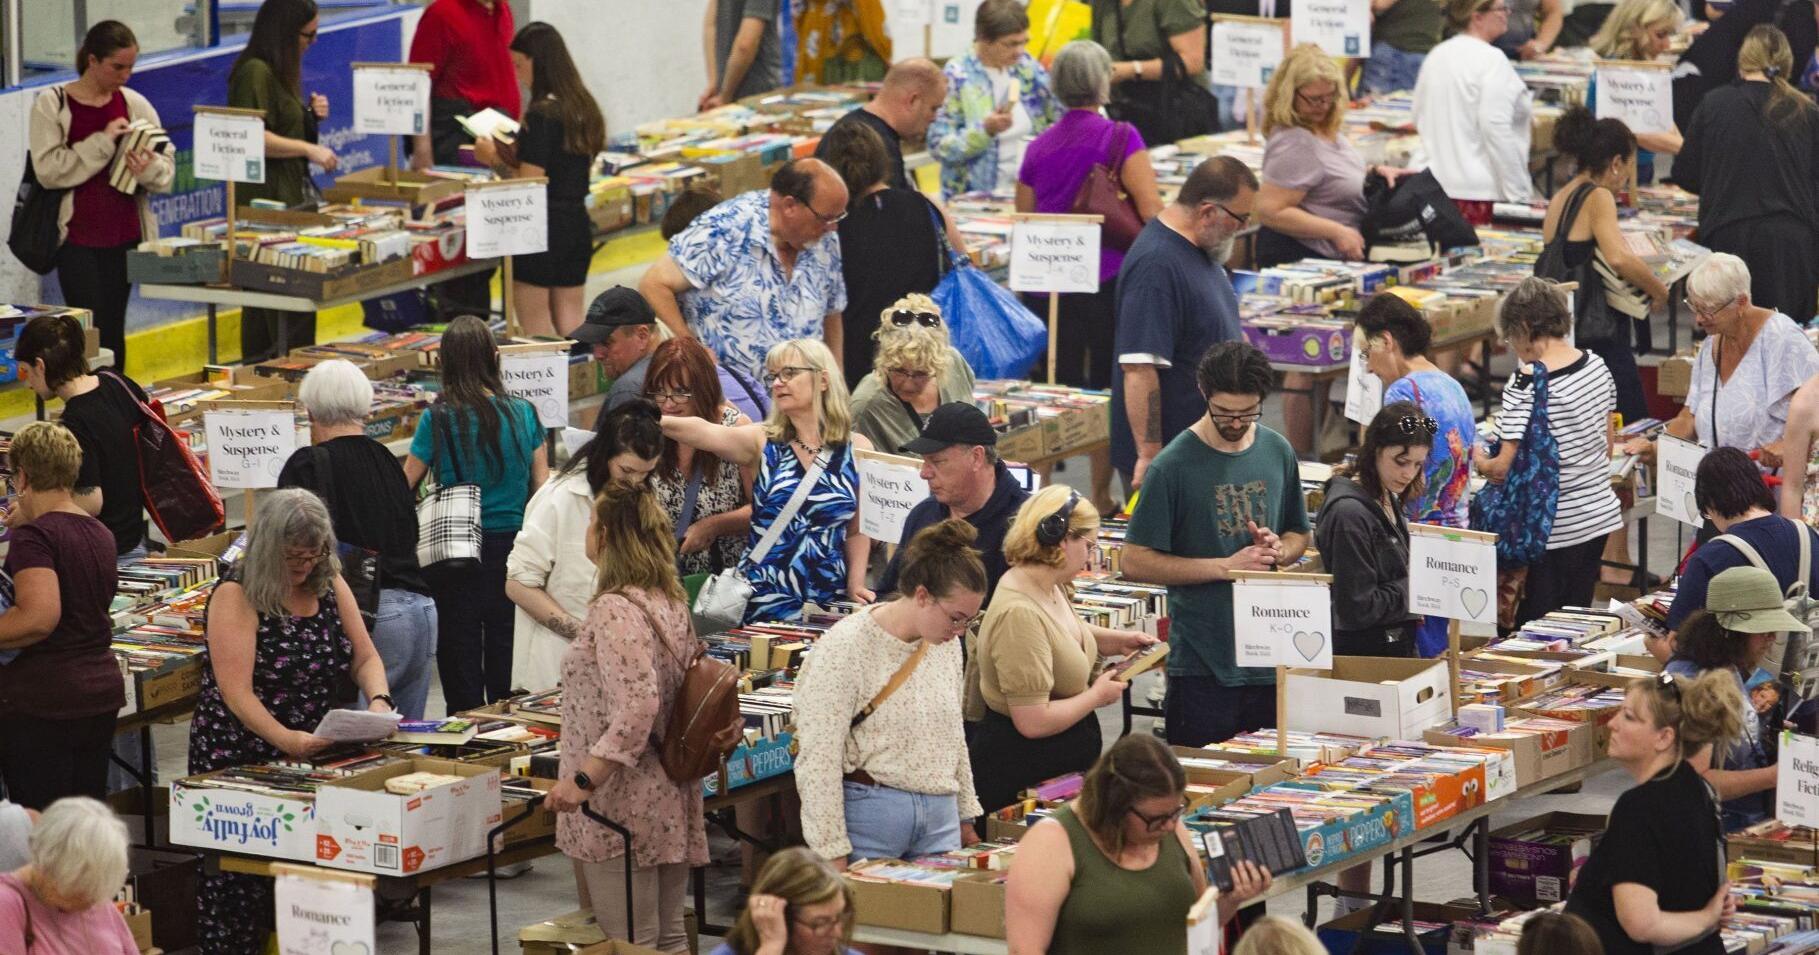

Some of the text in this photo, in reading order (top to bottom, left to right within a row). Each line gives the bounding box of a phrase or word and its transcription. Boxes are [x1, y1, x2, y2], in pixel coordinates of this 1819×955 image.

[1307, 3, 1347, 14] General
[1310, 18, 1345, 28] Fiction
[1226, 34, 1262, 45] General
[1229, 48, 1261, 59] Fiction
[374, 82, 416, 92] General
[1607, 79, 1645, 94] Mystery
[377, 97, 414, 106] Fiction
[1609, 94, 1655, 107] Suspense
[209, 127, 248, 140] General
[212, 143, 246, 155] Fiction
[481, 195, 534, 212] Mystery &
[484, 213, 534, 226] Suspense
[1026, 234, 1086, 250] Mystery &
[1028, 252, 1083, 265] Suspense
[545, 366, 555, 378] &
[219, 424, 281, 440] Mystery &
[222, 444, 279, 459] Suspense
[865, 472, 913, 494] Mystery &
[867, 491, 912, 510] Suspense
[1425, 556, 1479, 575] Romance
[1251, 605, 1311, 618] Romance
[1270, 623, 1293, 634] K-O
[752, 744, 791, 774] PEPPERS
[215, 802, 254, 817] grown
[202, 810, 281, 846] joyfully
[1350, 818, 1386, 848] PEPPERS
[291, 904, 351, 926] Romance
